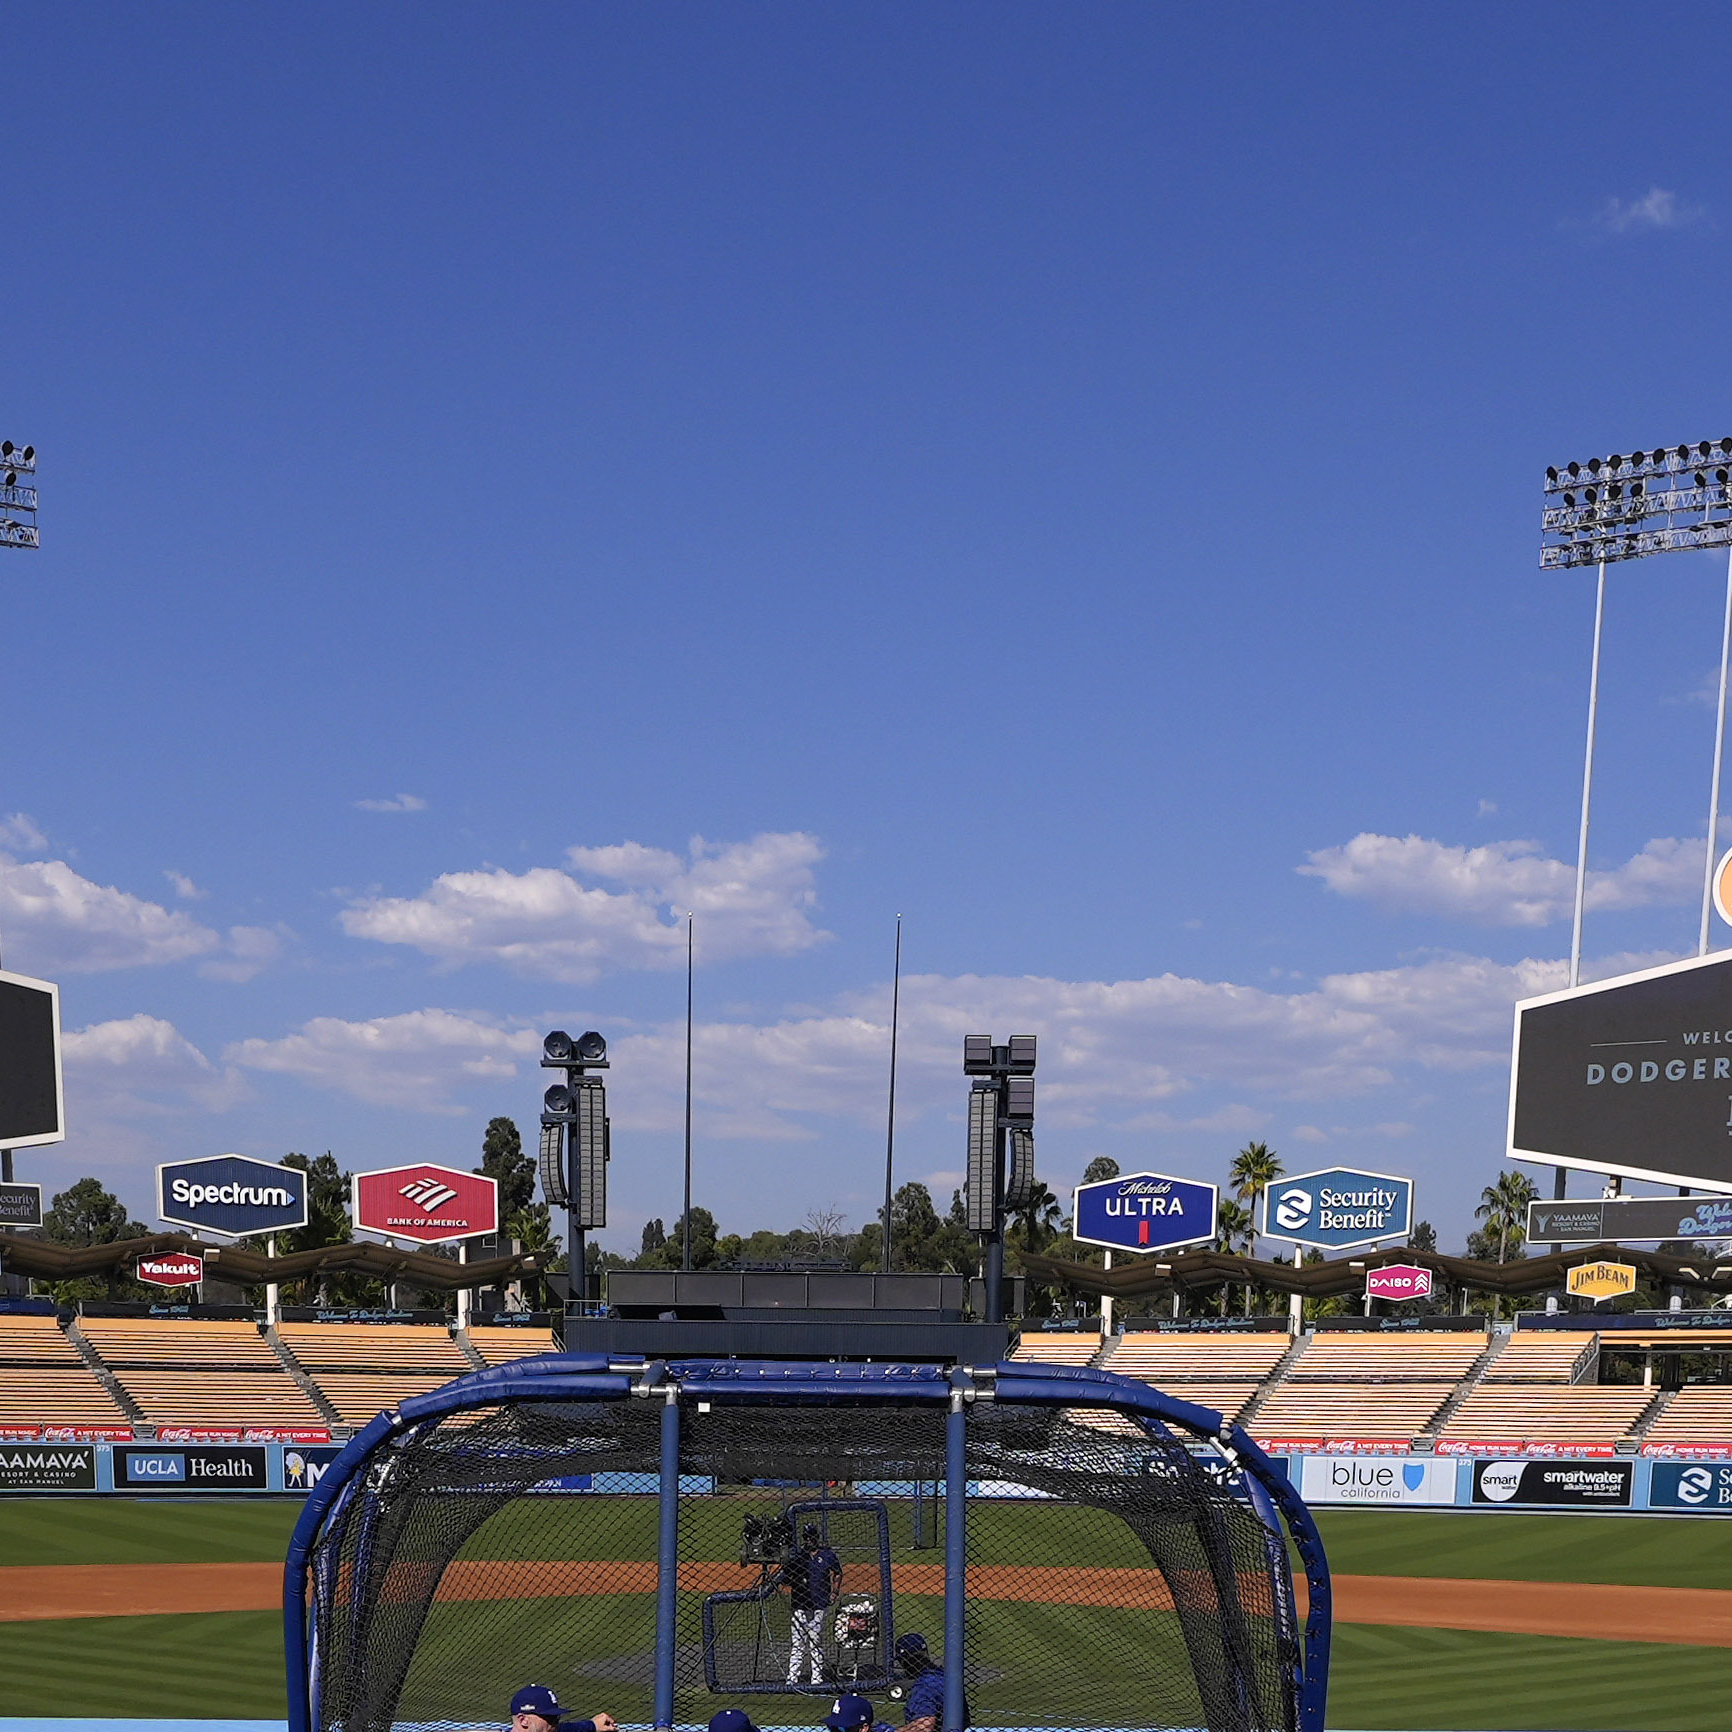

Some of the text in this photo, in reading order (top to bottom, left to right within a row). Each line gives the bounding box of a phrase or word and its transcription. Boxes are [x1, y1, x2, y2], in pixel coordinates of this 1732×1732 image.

[1585, 1057, 1731, 1086] DODGER
[171, 1178, 288, 1210] Spectrum
[1319, 1186, 1398, 1214] Security
[1105, 1196, 1184, 1218] ULTRA
[387, 1217, 468, 1228] BANK OF AMERICA
[1319, 1208, 1386, 1230] Benefit
[141, 1261, 199, 1277] Yakult
[1571, 1264, 1630, 1290] JIM BEAM
[1370, 1277, 1412, 1289] DAISO
[133, 1458, 255, 1477] UCLA Health
[1332, 1462, 1394, 1486] blue
[1543, 1471, 1625, 1484] smartwater
[1482, 1474, 1518, 1486] smart
[1341, 1486, 1401, 1499] california
